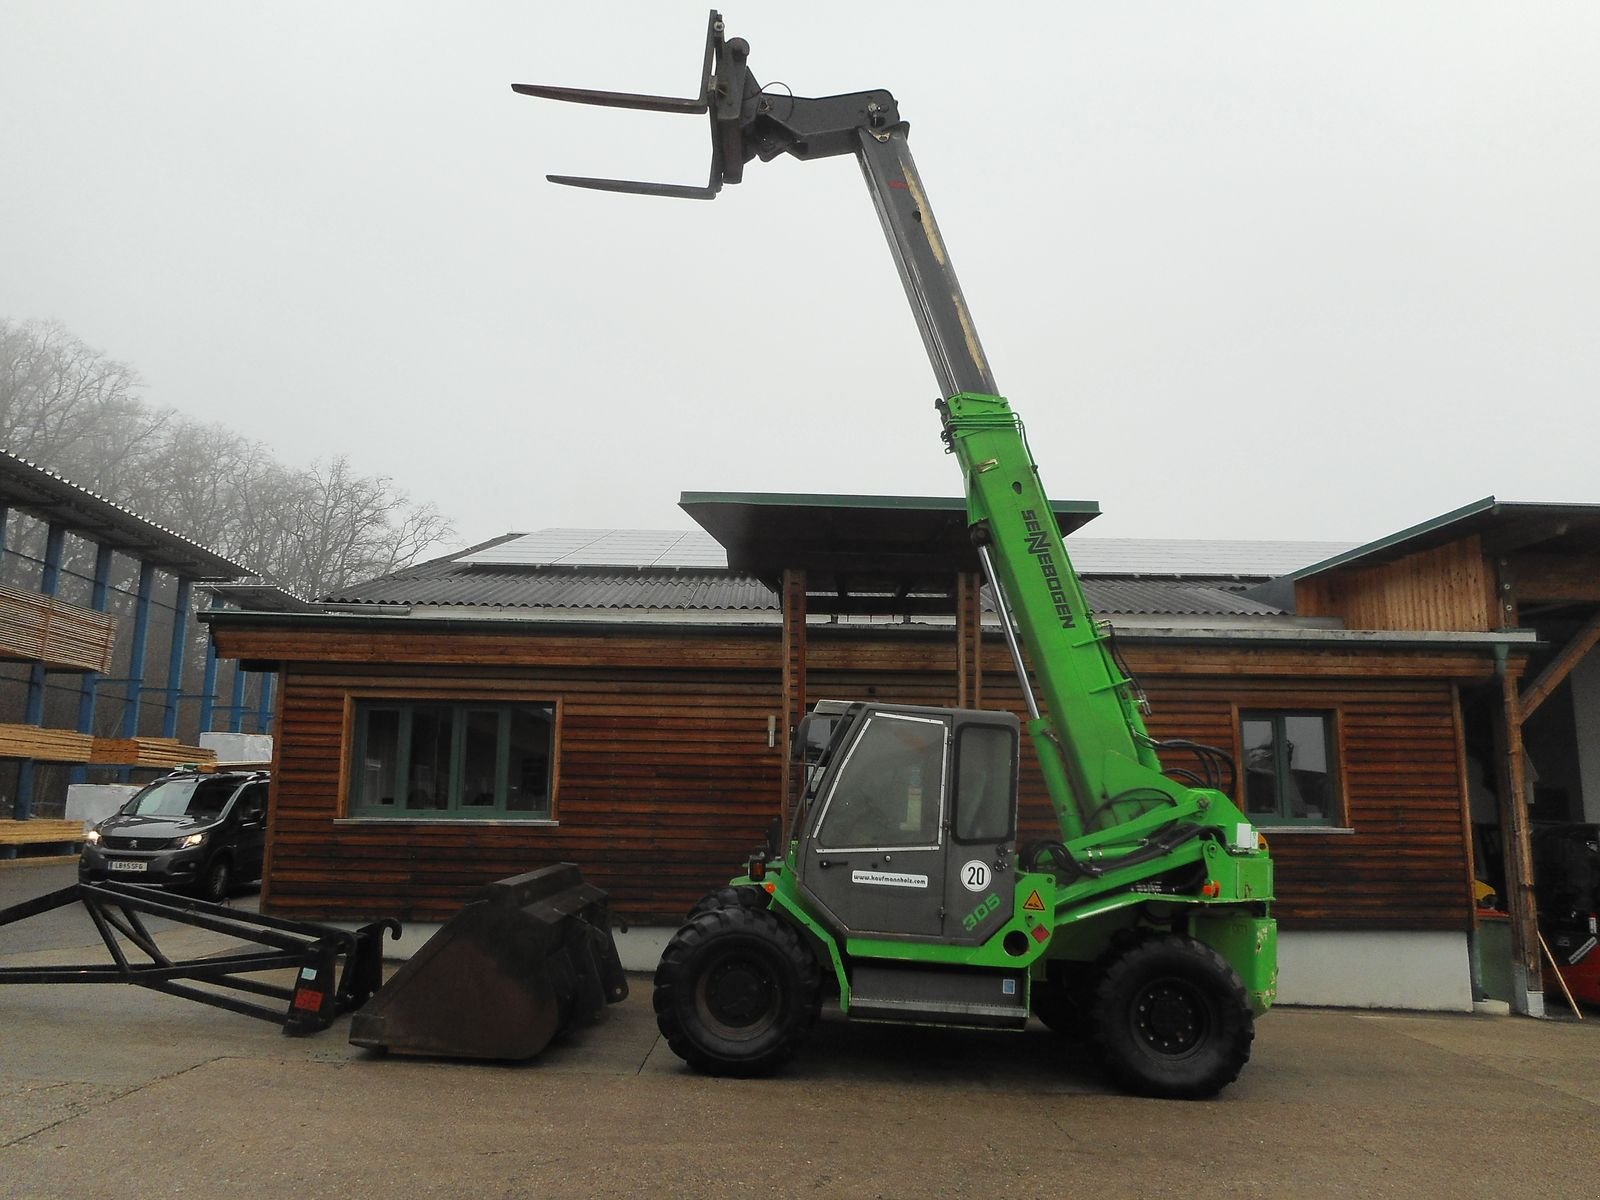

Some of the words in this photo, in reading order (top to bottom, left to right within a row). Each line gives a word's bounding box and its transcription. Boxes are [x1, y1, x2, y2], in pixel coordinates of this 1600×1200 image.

[1021, 509, 1076, 629] SENNEBOGEN
[967, 866, 985, 885] 20
[962, 893, 1000, 931] 305
